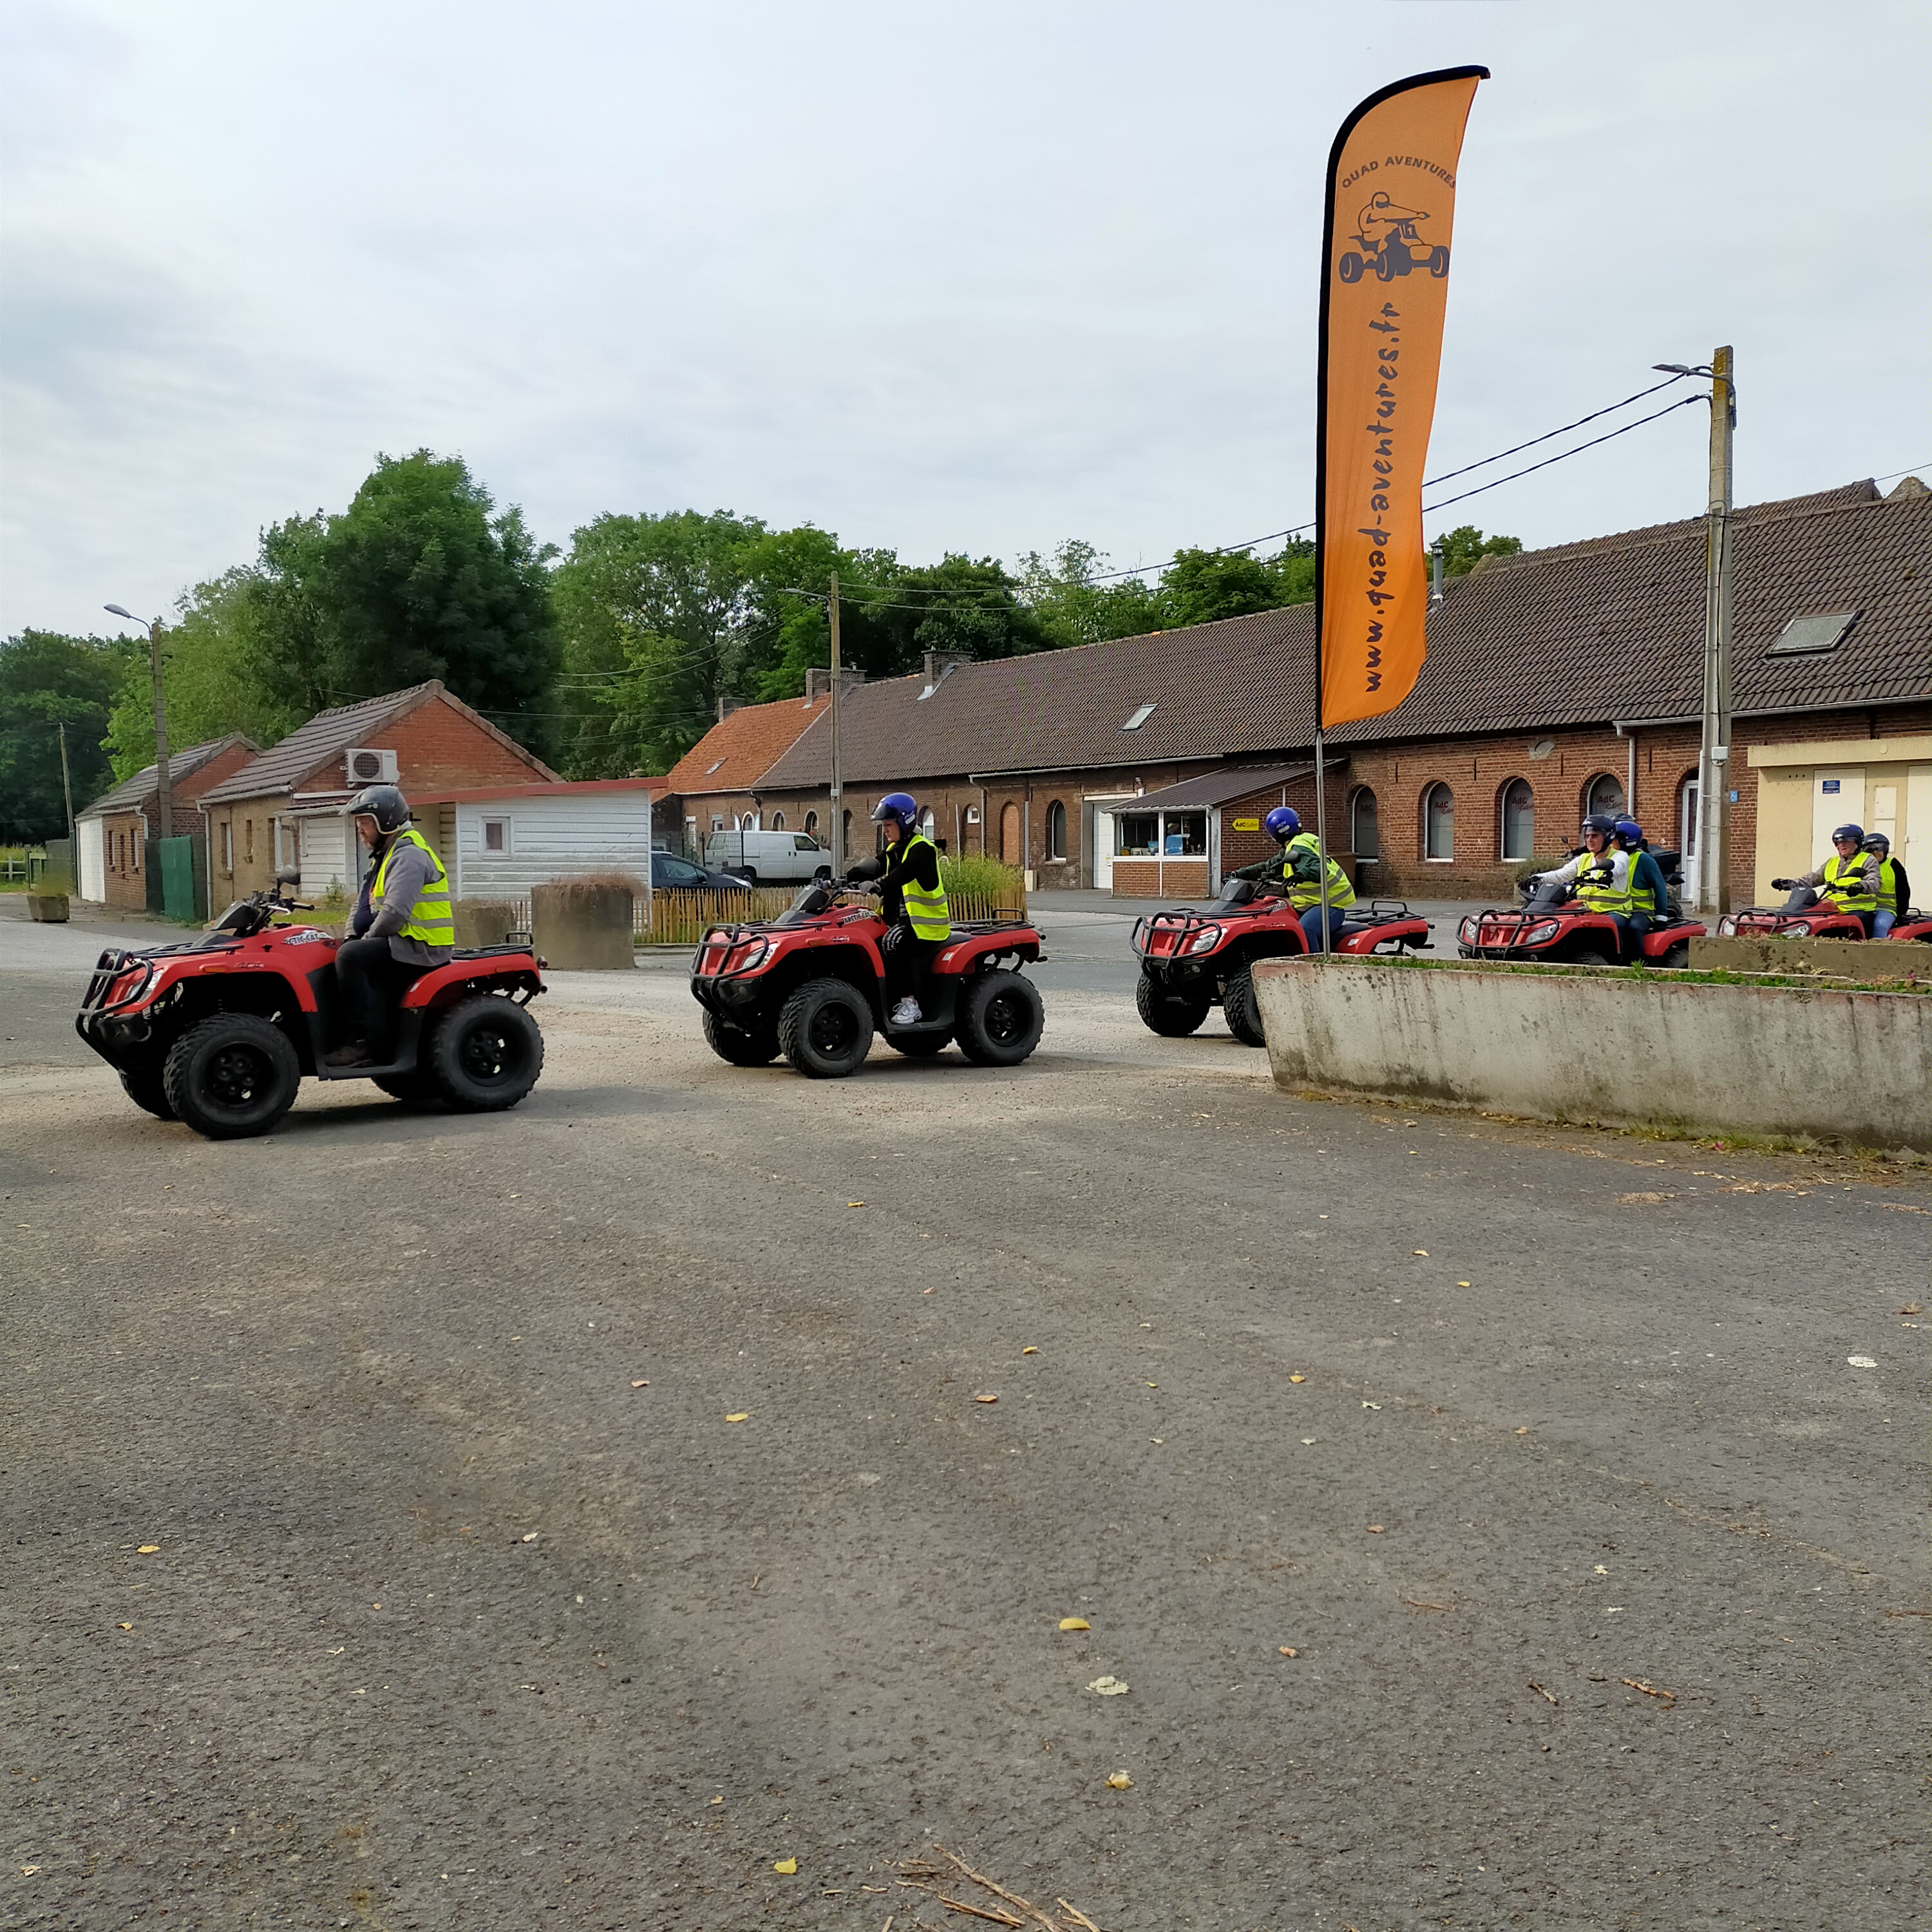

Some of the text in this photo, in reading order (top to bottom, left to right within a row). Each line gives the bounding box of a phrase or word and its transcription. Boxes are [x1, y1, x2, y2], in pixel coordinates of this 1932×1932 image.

[1341, 156, 1456, 189] QUAD AVENTURES
[1357, 301, 1401, 693] www.quad-aventures.fr
[844, 914, 861, 923] ARCTIC
[306, 934, 319, 942] CAT
